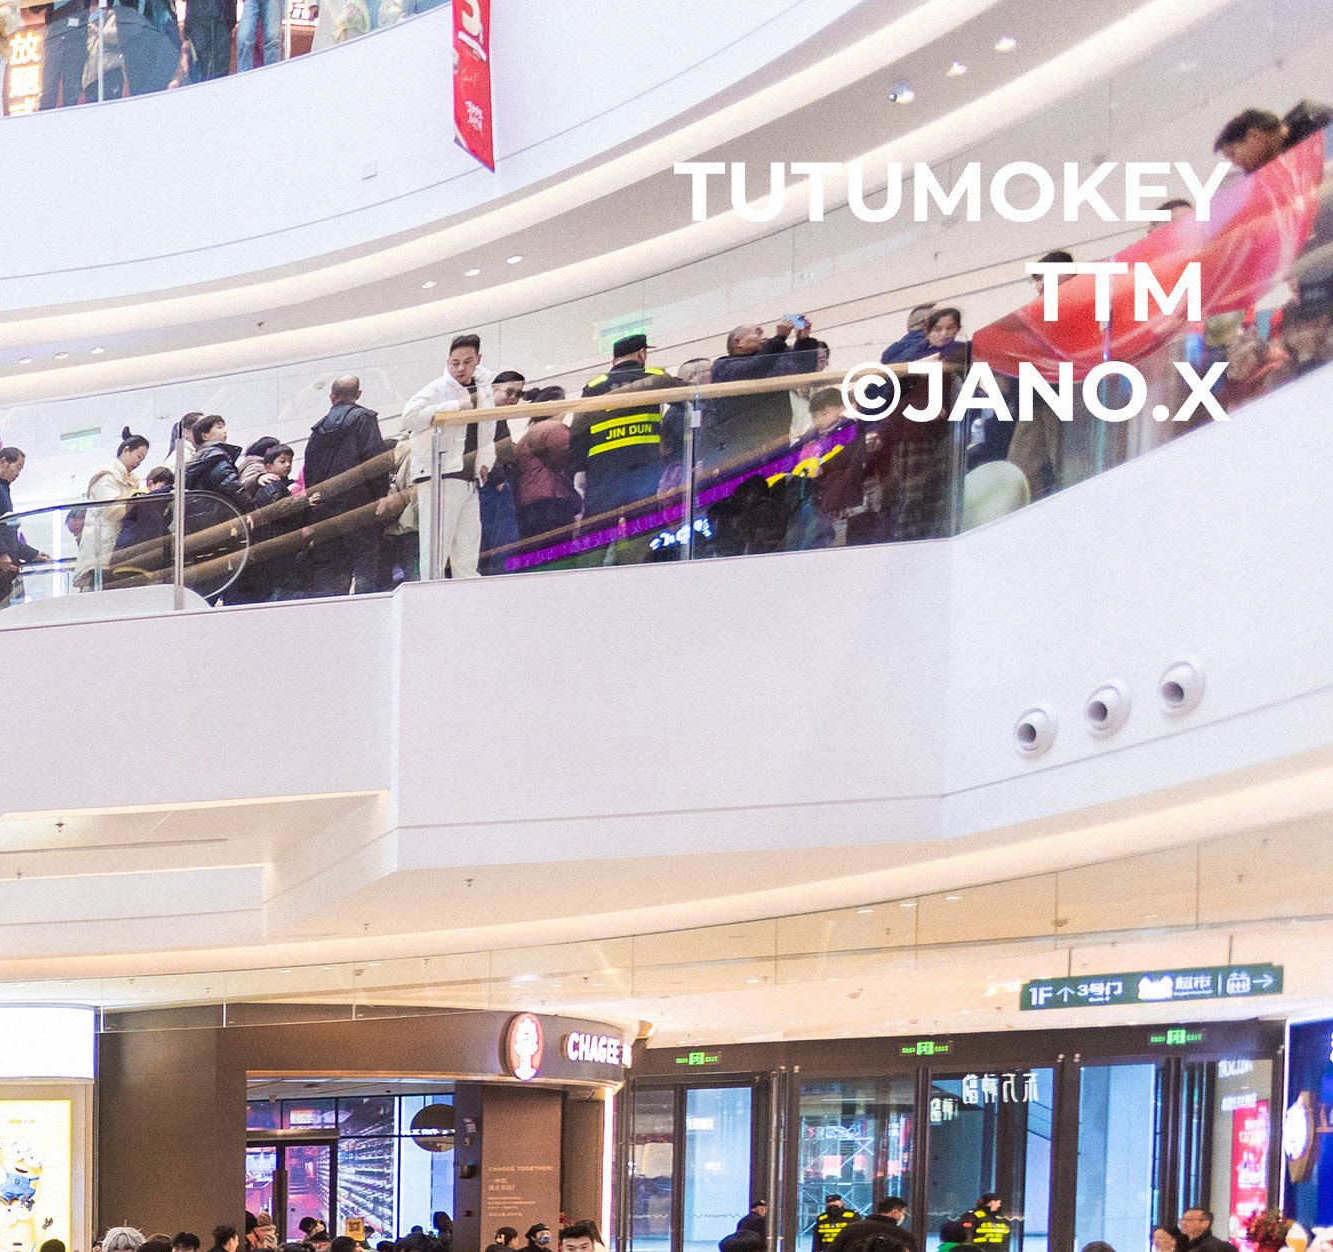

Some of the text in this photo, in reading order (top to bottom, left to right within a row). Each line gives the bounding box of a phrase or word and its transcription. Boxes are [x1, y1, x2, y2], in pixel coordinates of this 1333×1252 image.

[605, 423, 652, 440] JIN DUN
[1029, 984, 1054, 1006] 1F
[567, 1031, 620, 1066] CHAGEE
